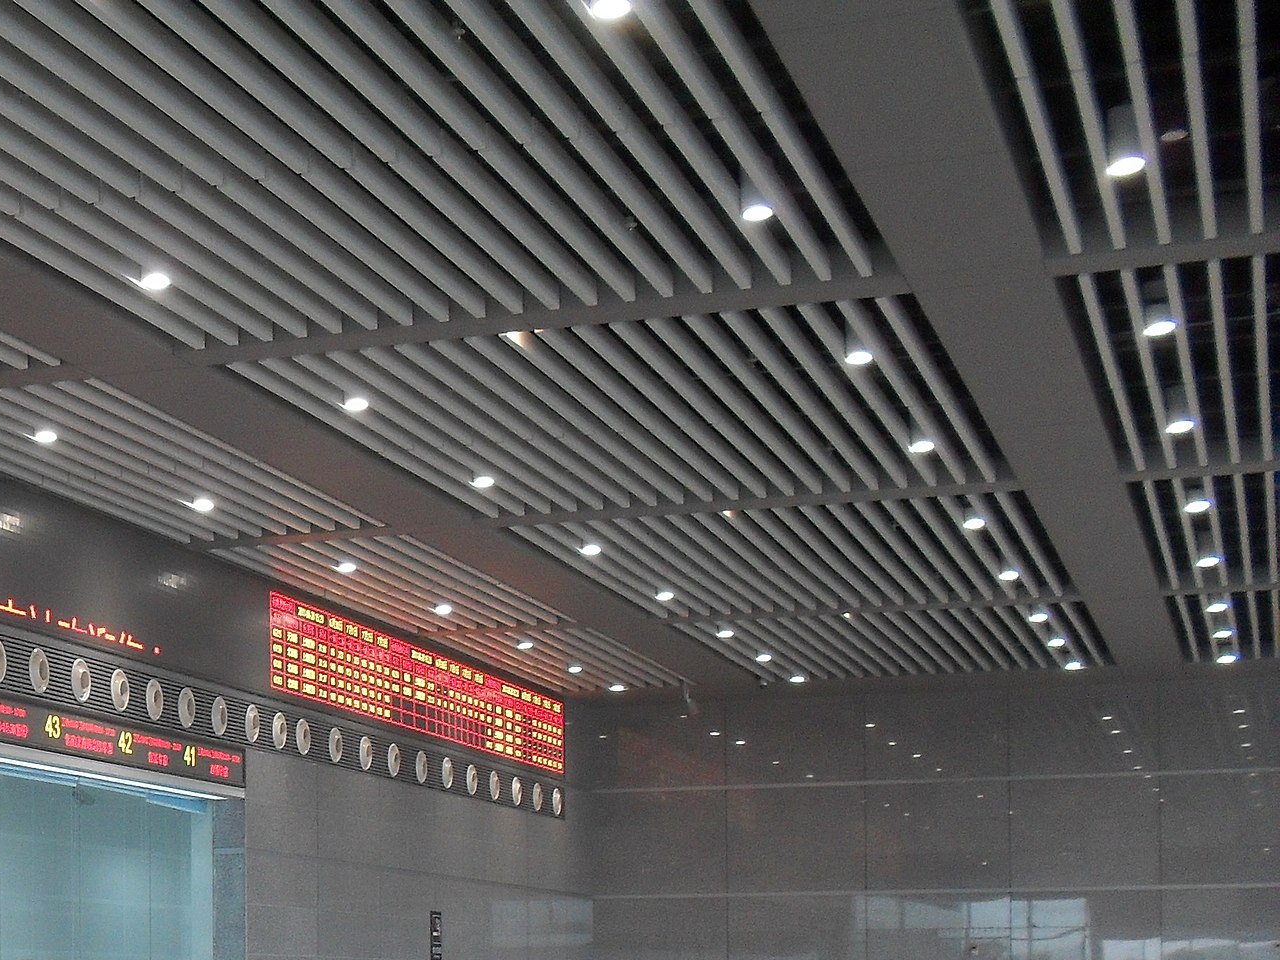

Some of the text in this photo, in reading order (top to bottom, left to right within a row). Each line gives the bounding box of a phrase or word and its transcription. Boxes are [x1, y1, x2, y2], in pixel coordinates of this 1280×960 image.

[45, 715, 60, 738] 43
[118, 731, 132, 754] 42
[184, 746, 195, 766] 41
